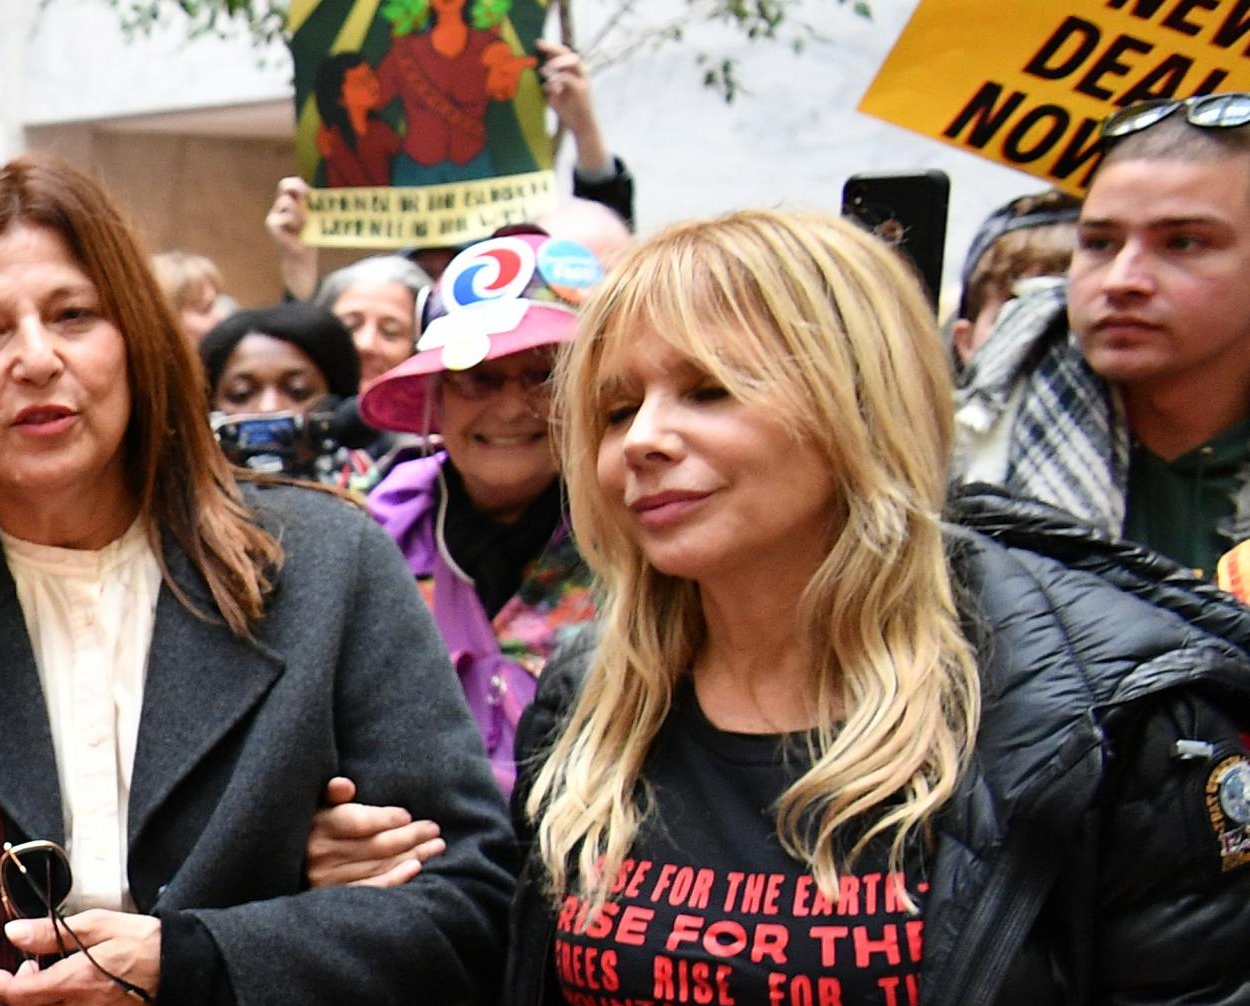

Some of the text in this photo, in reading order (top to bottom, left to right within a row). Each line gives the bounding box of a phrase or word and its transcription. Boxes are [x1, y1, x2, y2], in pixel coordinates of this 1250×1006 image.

[651, 863, 715, 909] FOR
[723, 870, 785, 915] THE
[557, 895, 655, 945] RISE
[665, 914, 789, 965] FOR
[653, 955, 735, 1006] RISE
